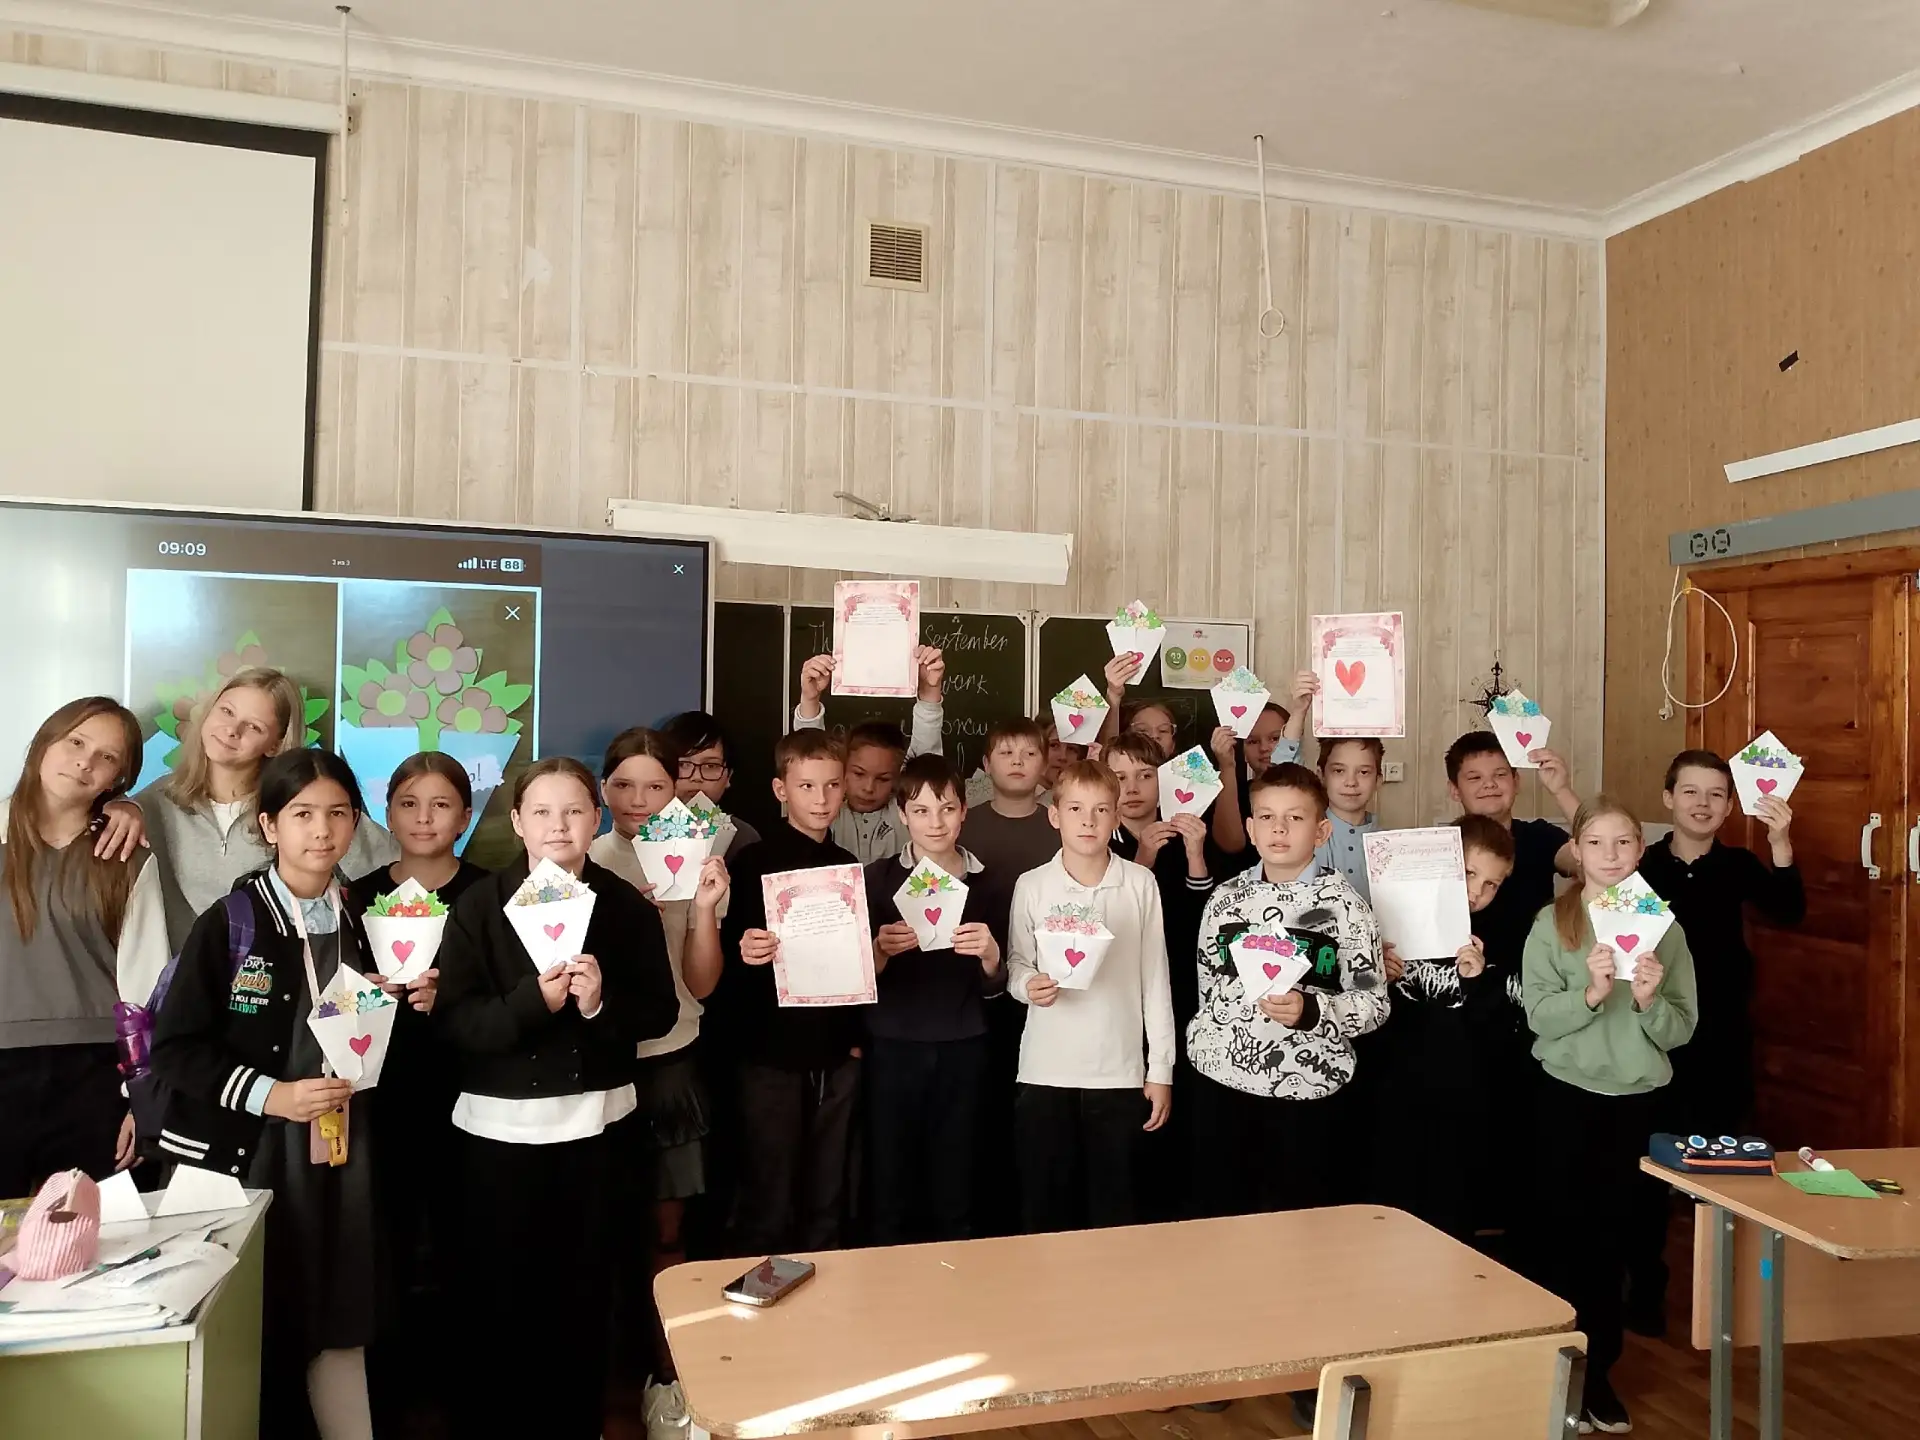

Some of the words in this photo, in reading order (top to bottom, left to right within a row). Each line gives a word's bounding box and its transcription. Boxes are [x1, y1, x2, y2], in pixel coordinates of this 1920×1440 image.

[158, 541, 207, 556] 09:09
[480, 559, 497, 570] LTE
[504, 560, 520, 570] 88
[925, 624, 1008, 652] September
[1231, 886, 1257, 903] GAME
[250, 996, 269, 1006] BEER
